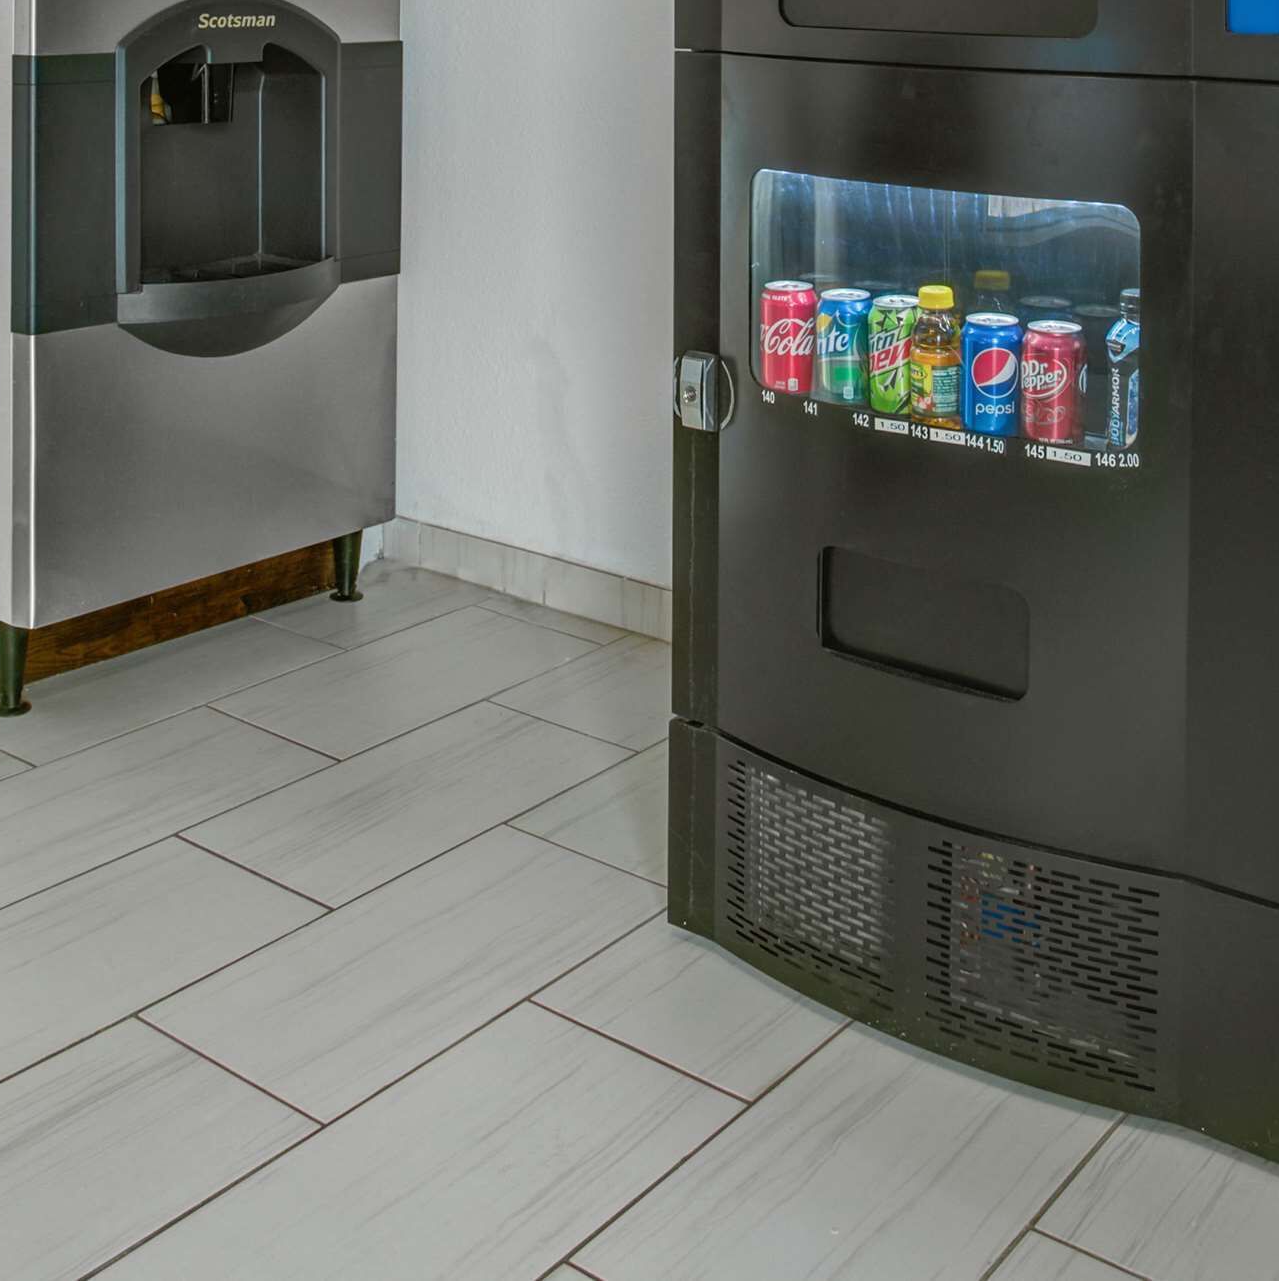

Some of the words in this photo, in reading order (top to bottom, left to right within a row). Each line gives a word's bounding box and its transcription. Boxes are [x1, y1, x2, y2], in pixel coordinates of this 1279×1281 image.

[198, 13, 276, 29] Scotsman
[764, 318, 814, 356] Cola
[1029, 360, 1048, 376] Dr
[761, 390, 776, 405] 140
[803, 400, 818, 416] 141
[975, 401, 1015, 416] pepsi
[852, 412, 870, 428] 142
[880, 421, 906, 431] 1.50
[910, 424, 929, 440] 143
[934, 431, 962, 442] 1.50
[965, 434, 984, 449] 144
[985, 438, 1005, 455] 1.50
[1025, 443, 1045, 460] 145
[1052, 450, 1082, 462] 1.50
[1095, 452, 1116, 467] 146
[1119, 453, 1140, 468] 2.00
